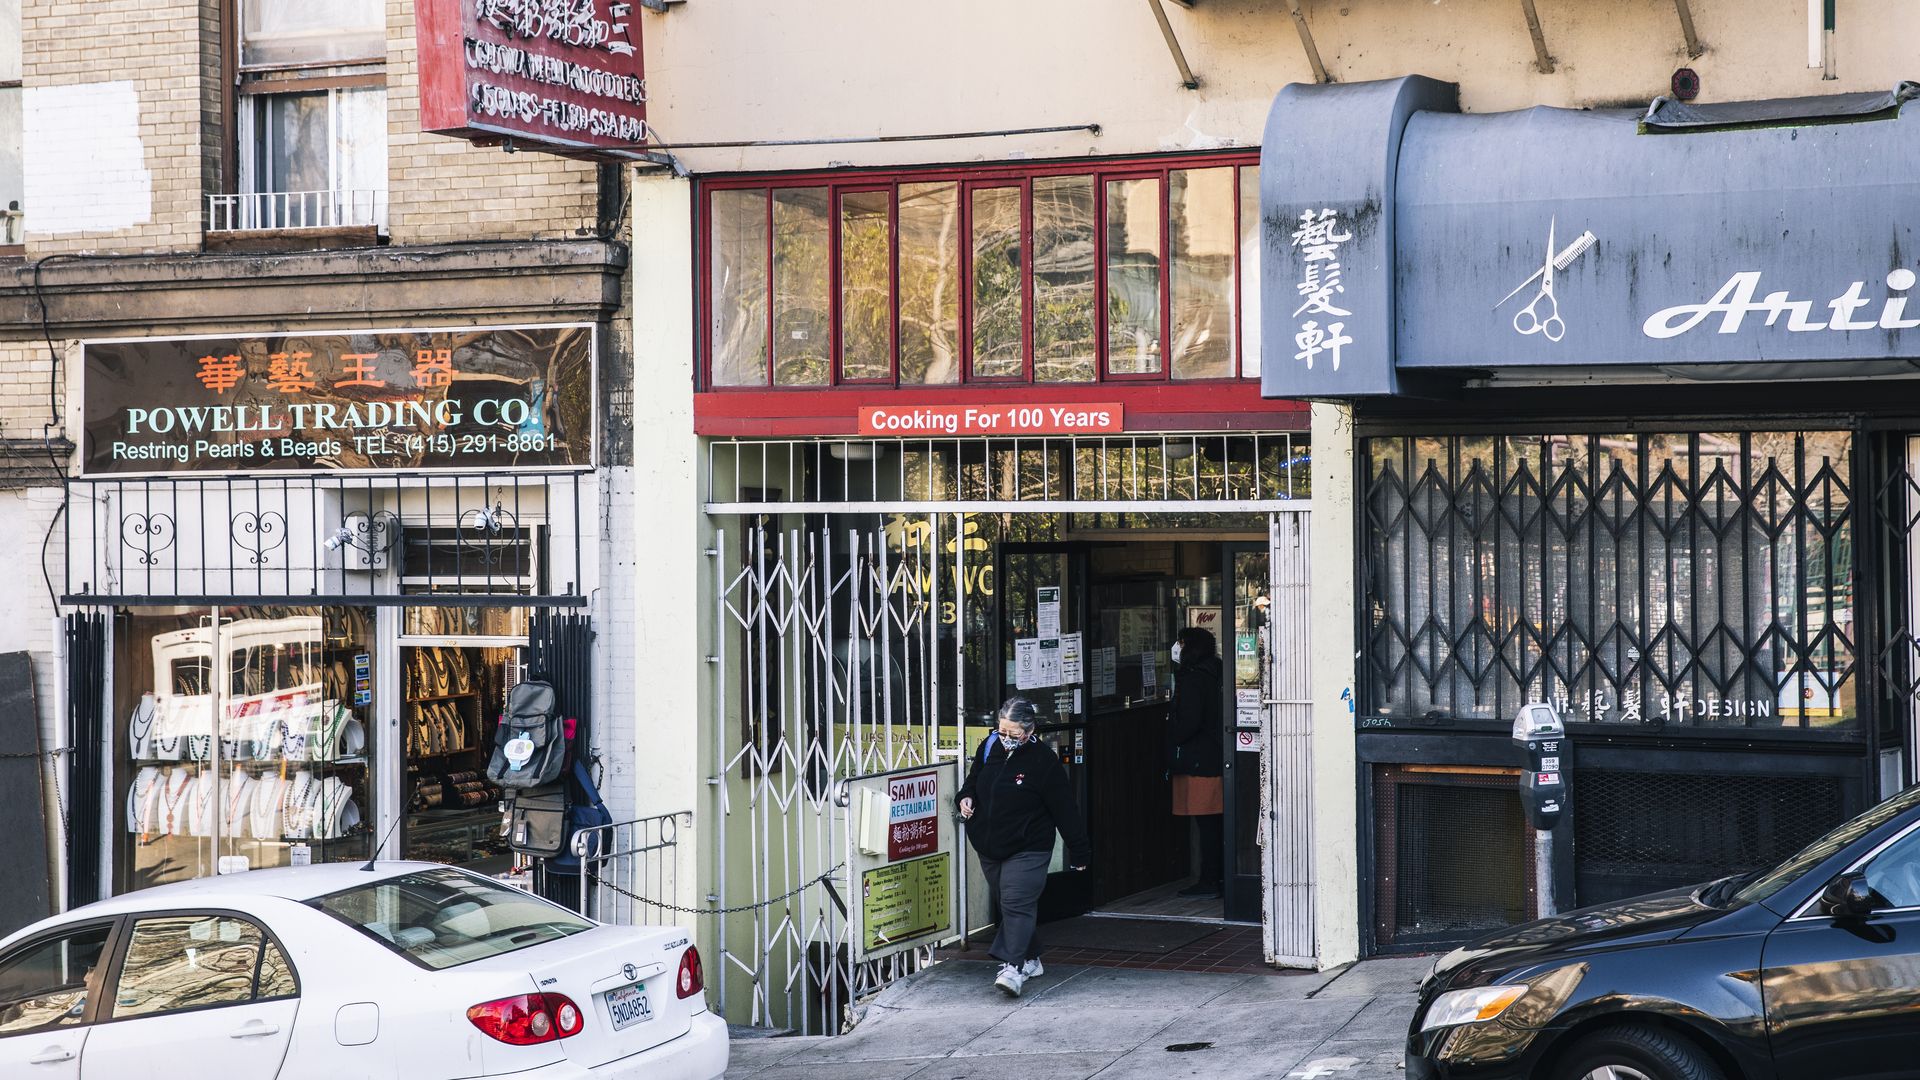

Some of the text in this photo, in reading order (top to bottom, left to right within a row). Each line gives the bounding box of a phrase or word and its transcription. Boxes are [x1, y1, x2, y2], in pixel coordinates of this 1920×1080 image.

[1292, 208, 1353, 371] 藝髮軒
[195, 349, 459, 395] 華藝玉器
[126, 398, 539, 434] POWELL TRADING CO.
[871, 407, 1110, 433] Cooking For 100 Years
[113, 433, 555, 462] Restring Pearls & Beads TEL: (415) 291-8861
[1698, 699, 1770, 718] DESIGN
[891, 779, 936, 802] SAM WO
[891, 799, 936, 818] RESTAURANT
[612, 995, 651, 1024] 5NDA852
